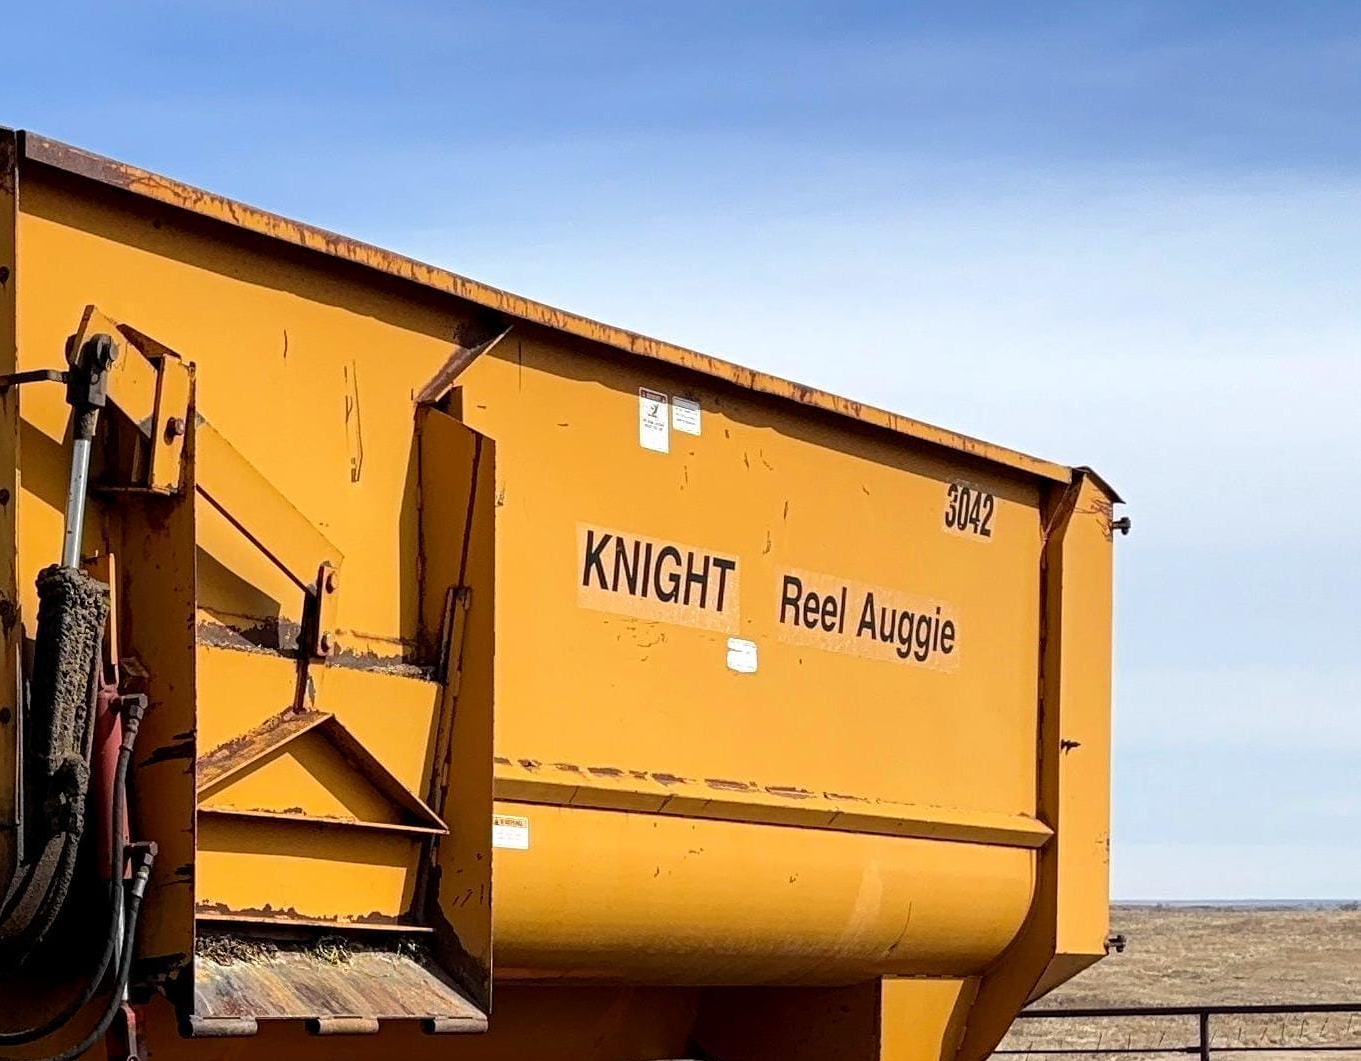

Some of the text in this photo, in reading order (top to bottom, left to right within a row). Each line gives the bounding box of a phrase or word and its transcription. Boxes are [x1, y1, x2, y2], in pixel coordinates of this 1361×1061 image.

[945, 483, 994, 538] 3042
[582, 529, 736, 612] KNIGHT
[779, 574, 956, 662] Reel Auggie
